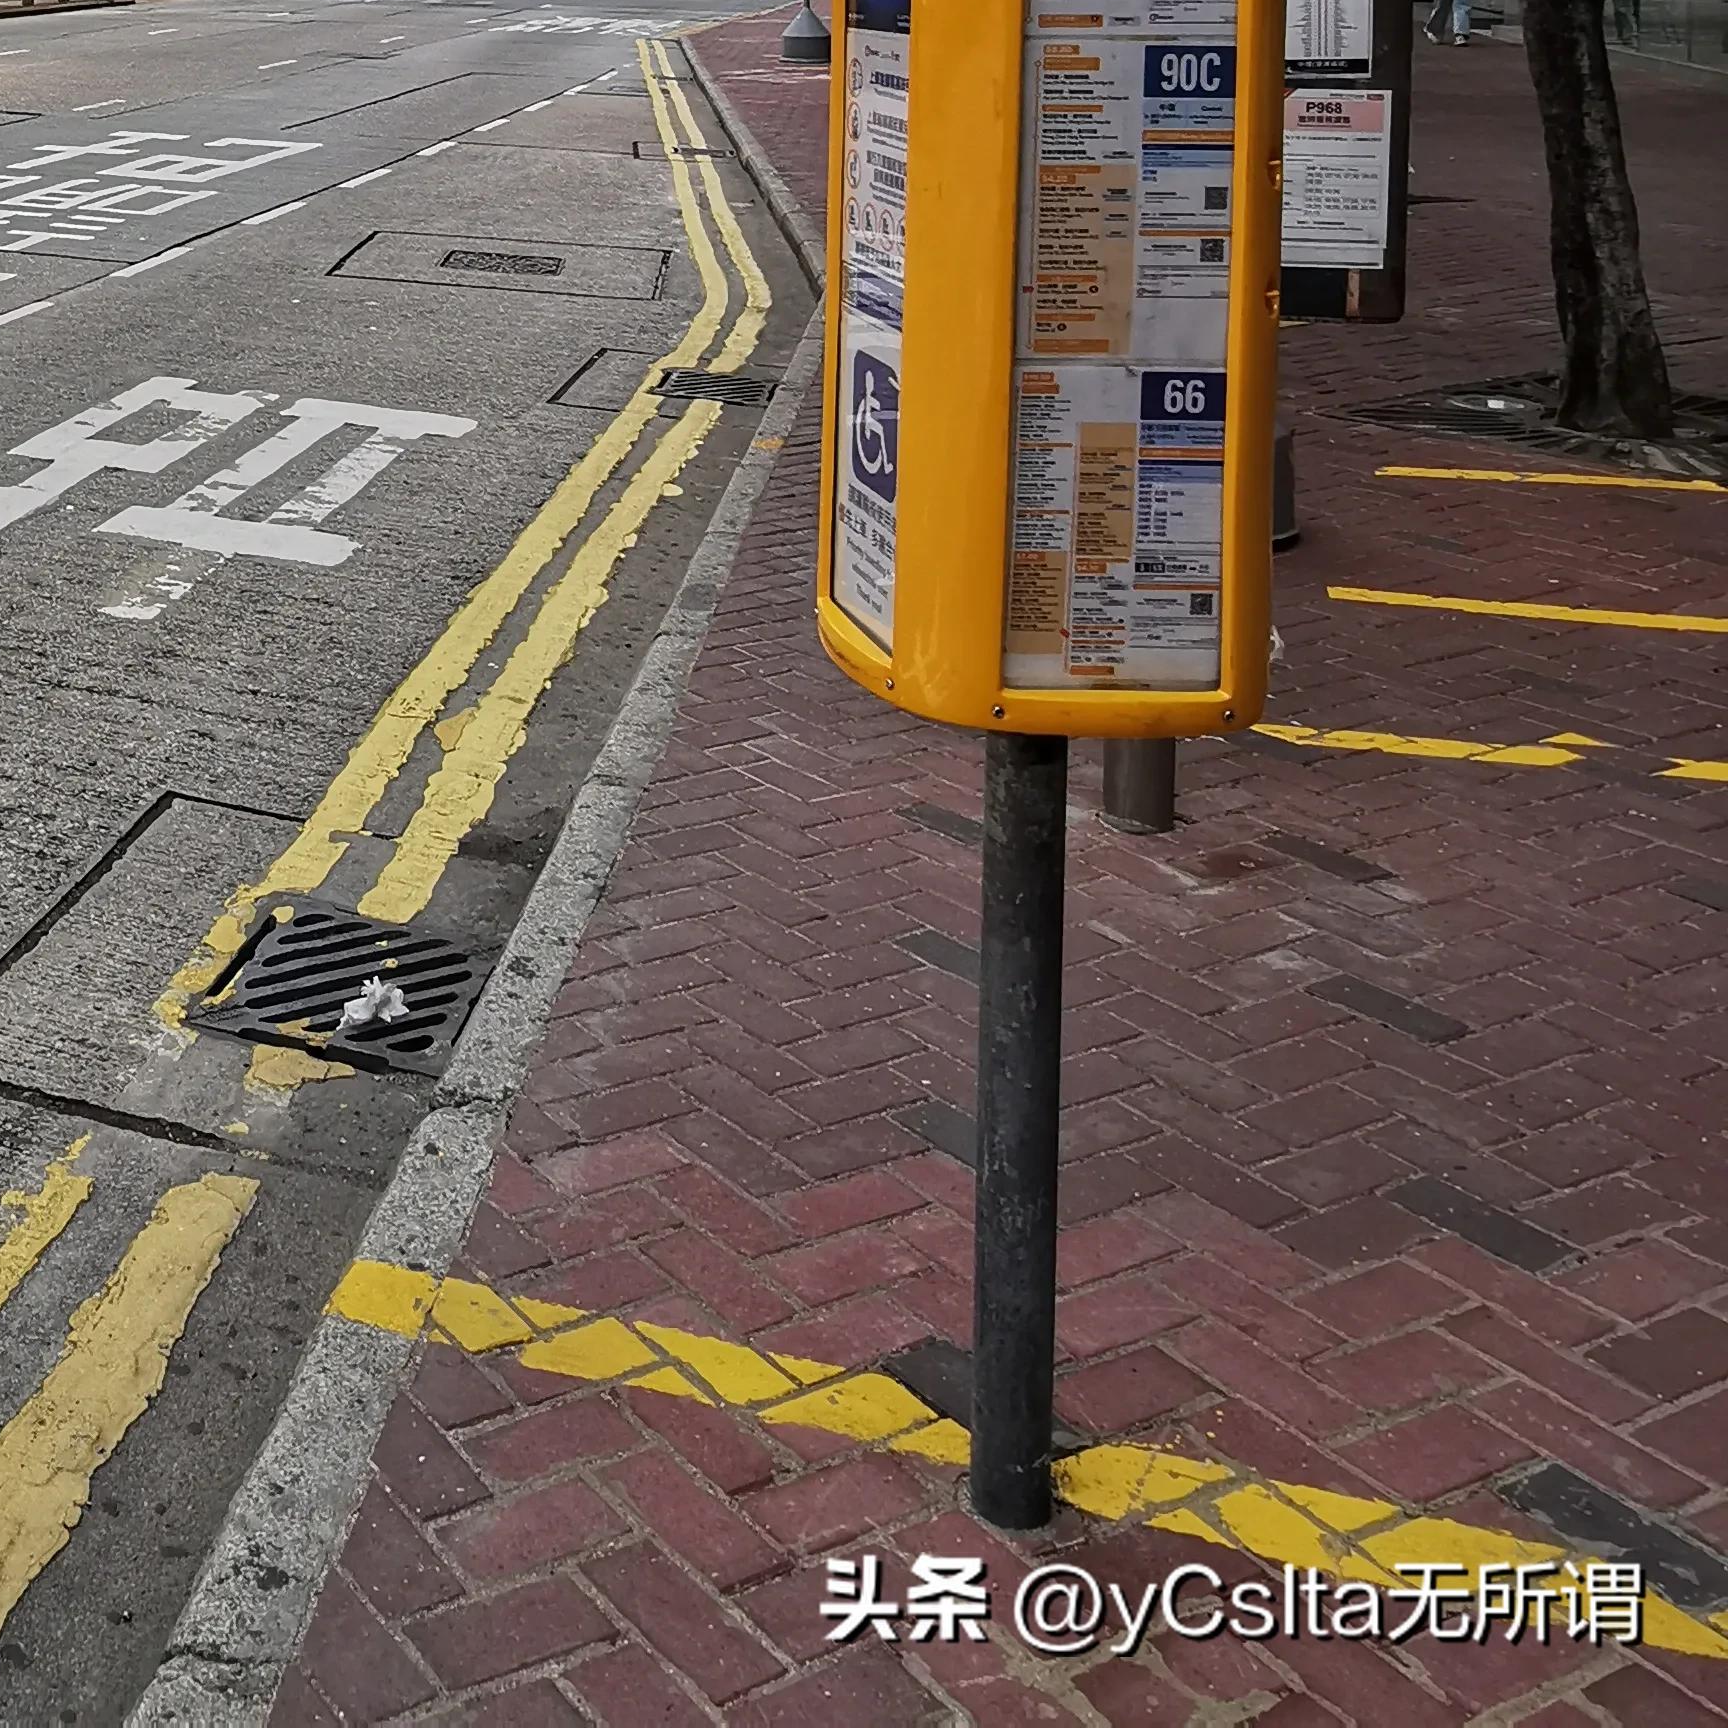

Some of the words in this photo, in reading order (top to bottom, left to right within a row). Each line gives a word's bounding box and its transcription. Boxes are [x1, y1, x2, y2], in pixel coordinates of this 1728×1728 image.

[1161, 52, 1221, 91] 90C
[1306, 102, 1342, 114] P968
[1164, 379, 1205, 413] 66
